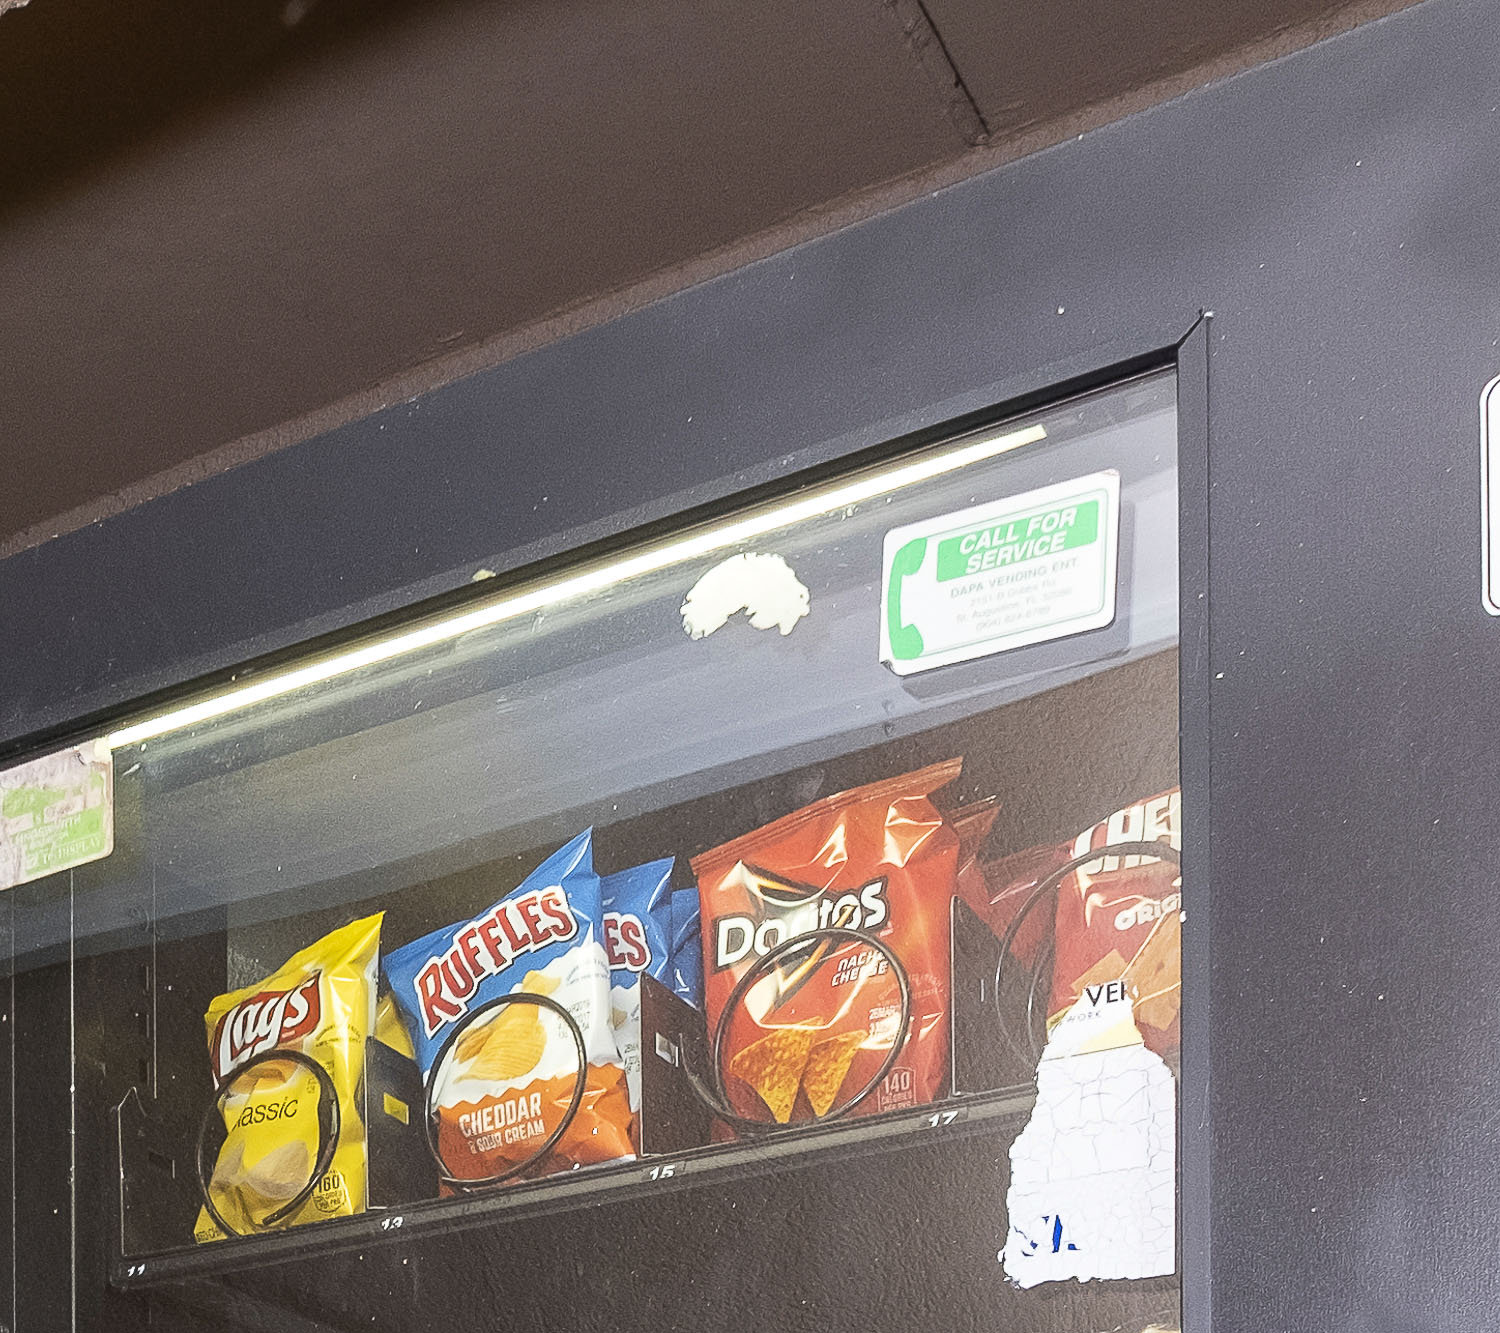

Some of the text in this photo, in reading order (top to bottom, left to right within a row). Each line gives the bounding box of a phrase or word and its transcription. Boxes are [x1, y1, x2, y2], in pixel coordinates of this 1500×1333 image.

[959, 507, 1078, 555] CALL FOR
[966, 531, 1067, 574] SERVICE
[951, 567, 1048, 599] DAPA VENDING
[716, 879, 890, 968] Doitos
[417, 888, 577, 1034] RUFFLES
[458, 1092, 542, 1138] CHEDDAR
[477, 1119, 545, 1153] SOUR CREAM
[928, 1111, 960, 1128] 17
[649, 1166, 676, 1181] 15
